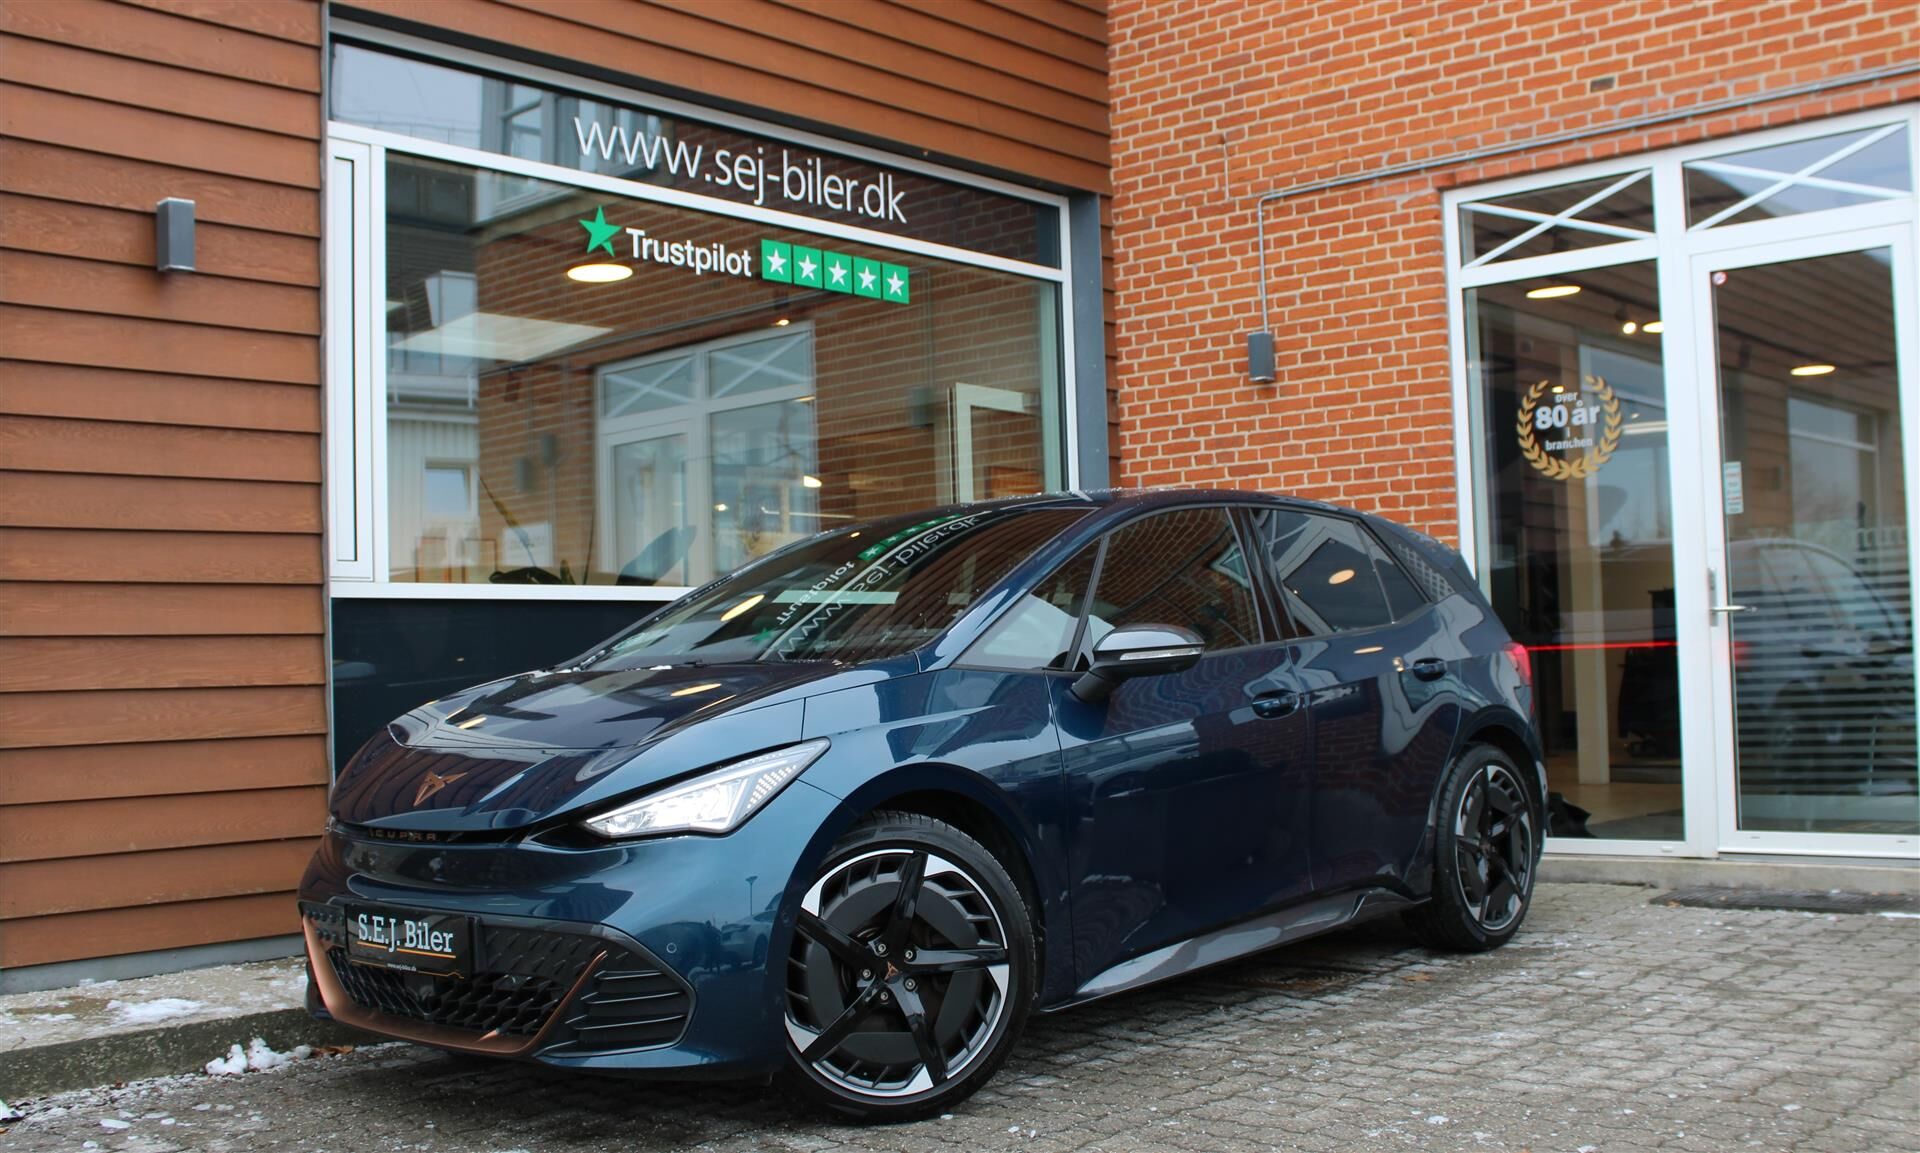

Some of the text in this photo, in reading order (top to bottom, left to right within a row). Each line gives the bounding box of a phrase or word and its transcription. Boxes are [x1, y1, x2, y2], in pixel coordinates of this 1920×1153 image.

[574, 117, 907, 224] www.sej-biler.dk
[625, 227, 752, 277] Trustpilot
[1535, 400, 1600, 430] 80 år
[1554, 392, 1578, 403] over
[1545, 438, 1593, 451] branchen
[358, 913, 454, 953] S.E.J. Biler
